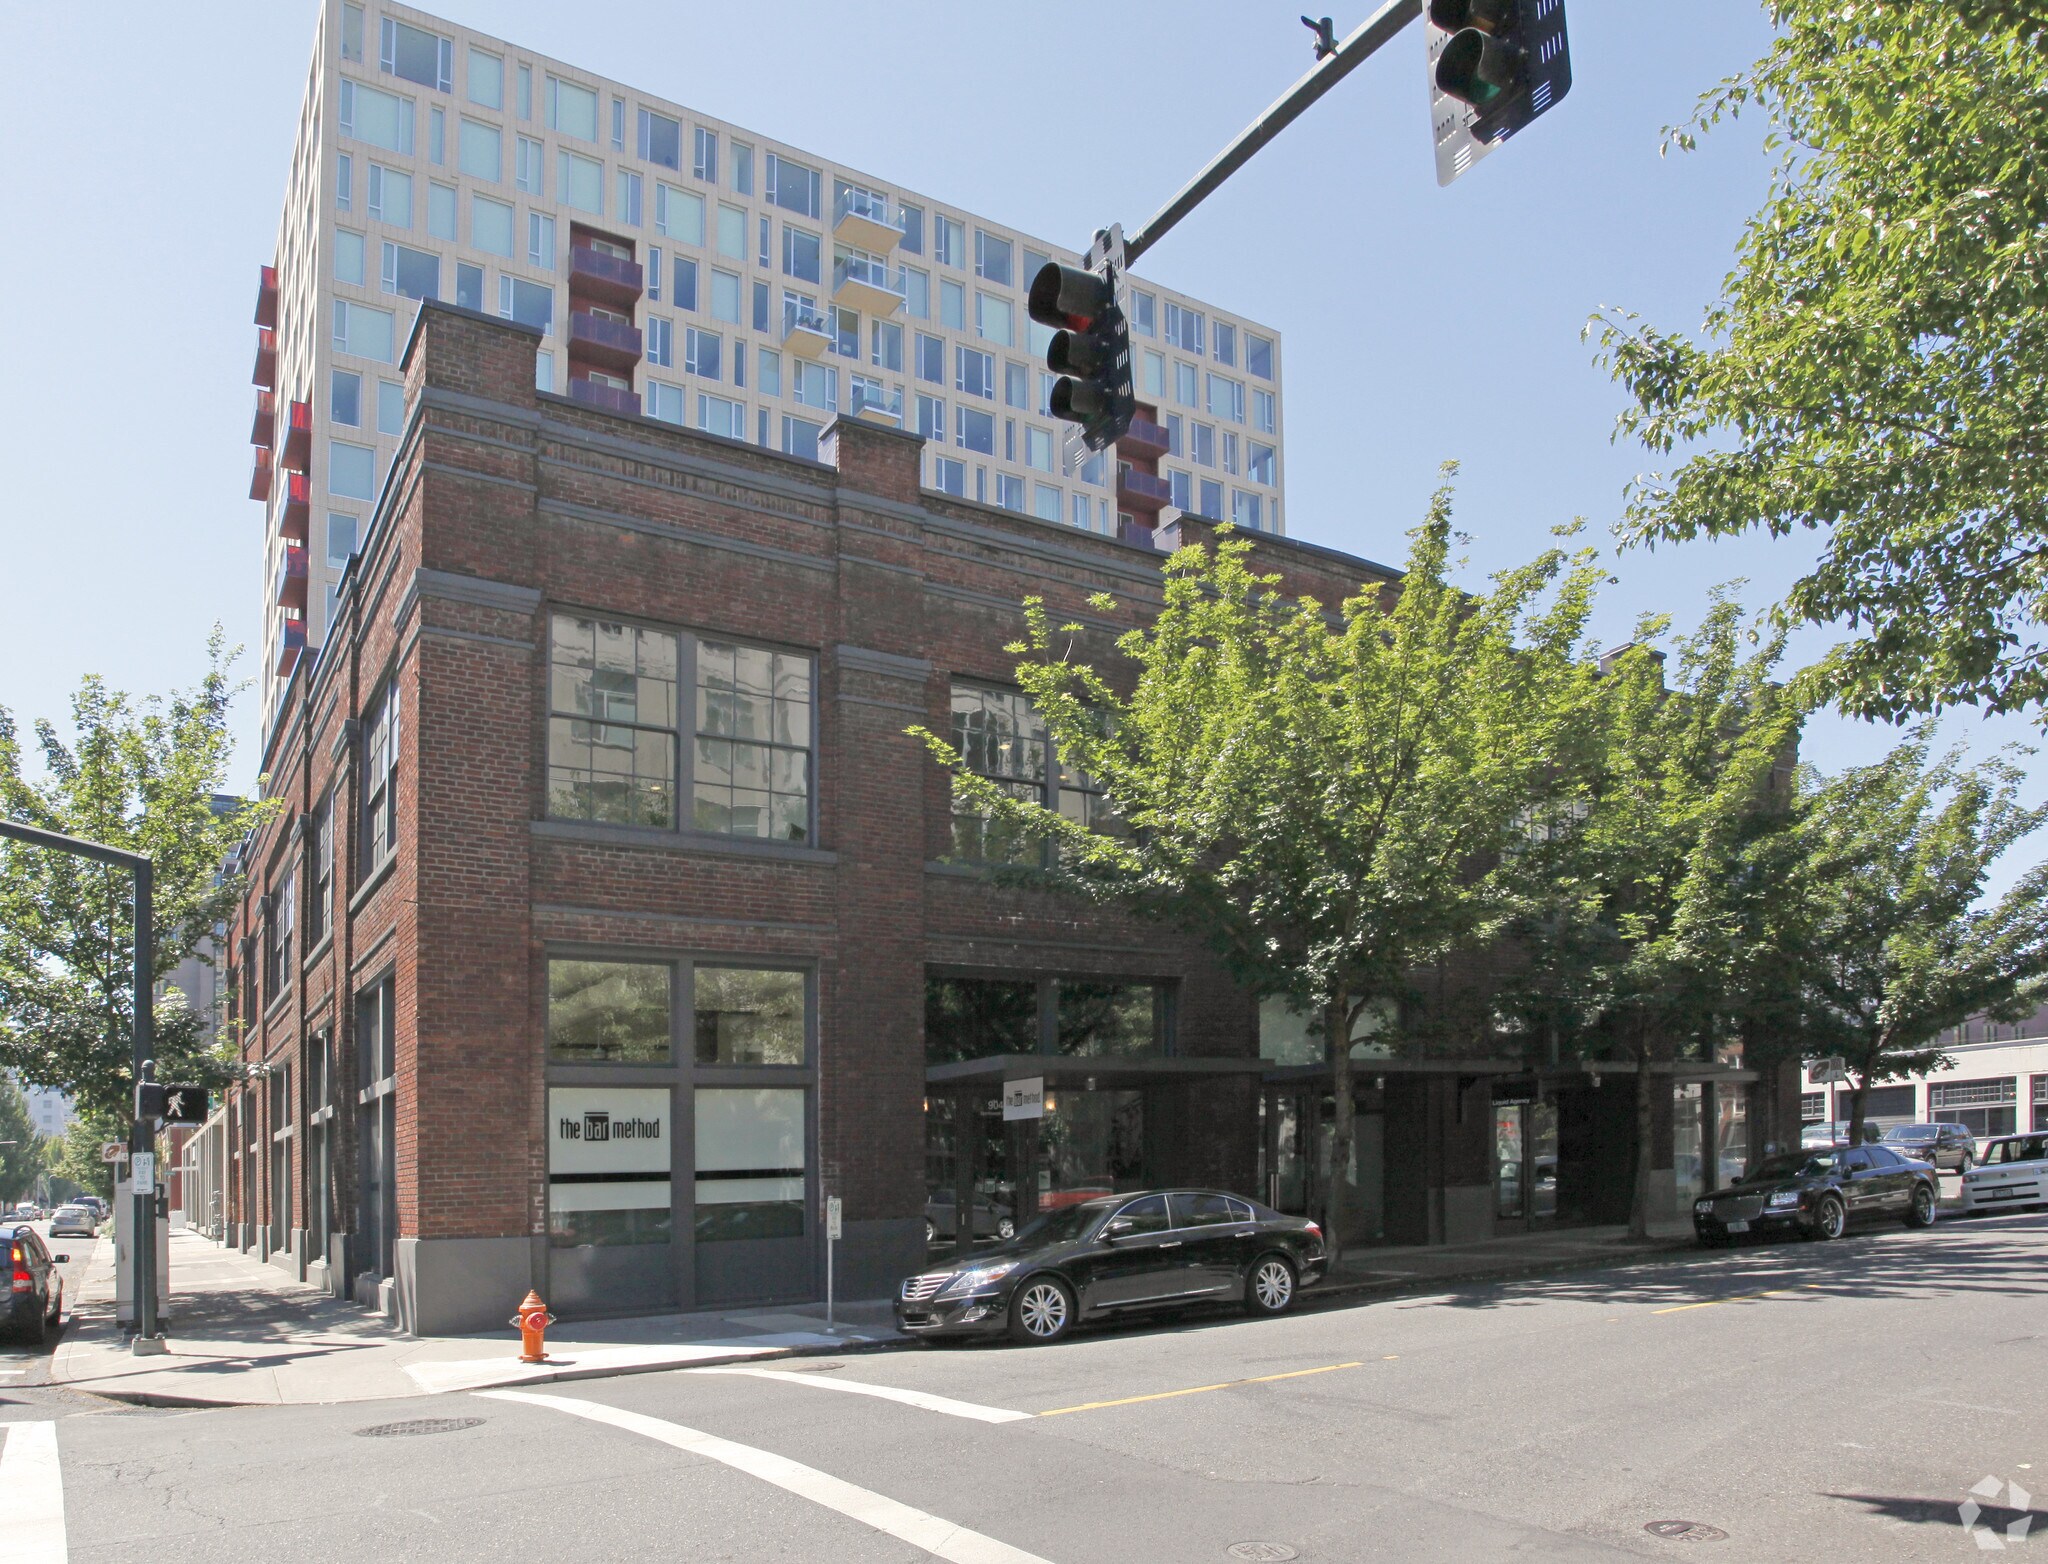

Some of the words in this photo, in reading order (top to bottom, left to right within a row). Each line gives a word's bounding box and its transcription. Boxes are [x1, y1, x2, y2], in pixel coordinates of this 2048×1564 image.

[560, 1118, 581, 1139] the
[584, 1115, 609, 1141] bar
[612, 1117, 660, 1139] method
